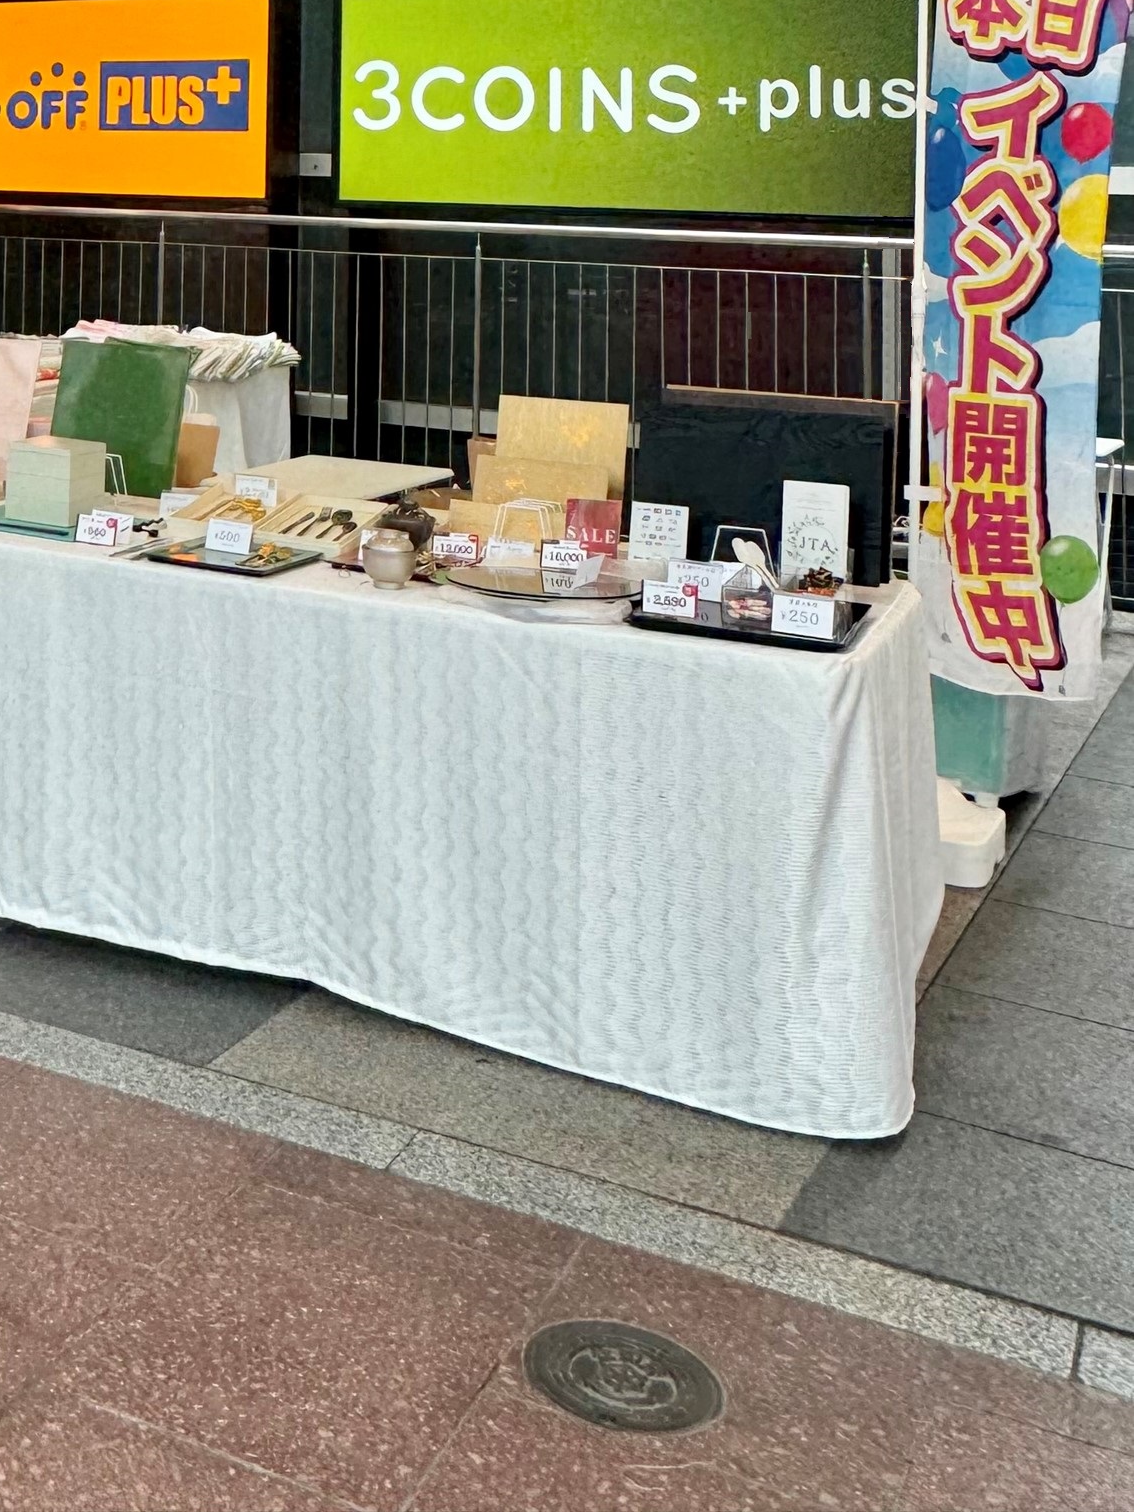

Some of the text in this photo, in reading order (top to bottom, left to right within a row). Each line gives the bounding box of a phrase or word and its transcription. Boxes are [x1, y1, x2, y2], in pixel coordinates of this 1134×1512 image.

[351, 58, 701, 134] 3COINS
[566, 525, 616, 544] SALE
[781, 609, 819, 626] ¥250
